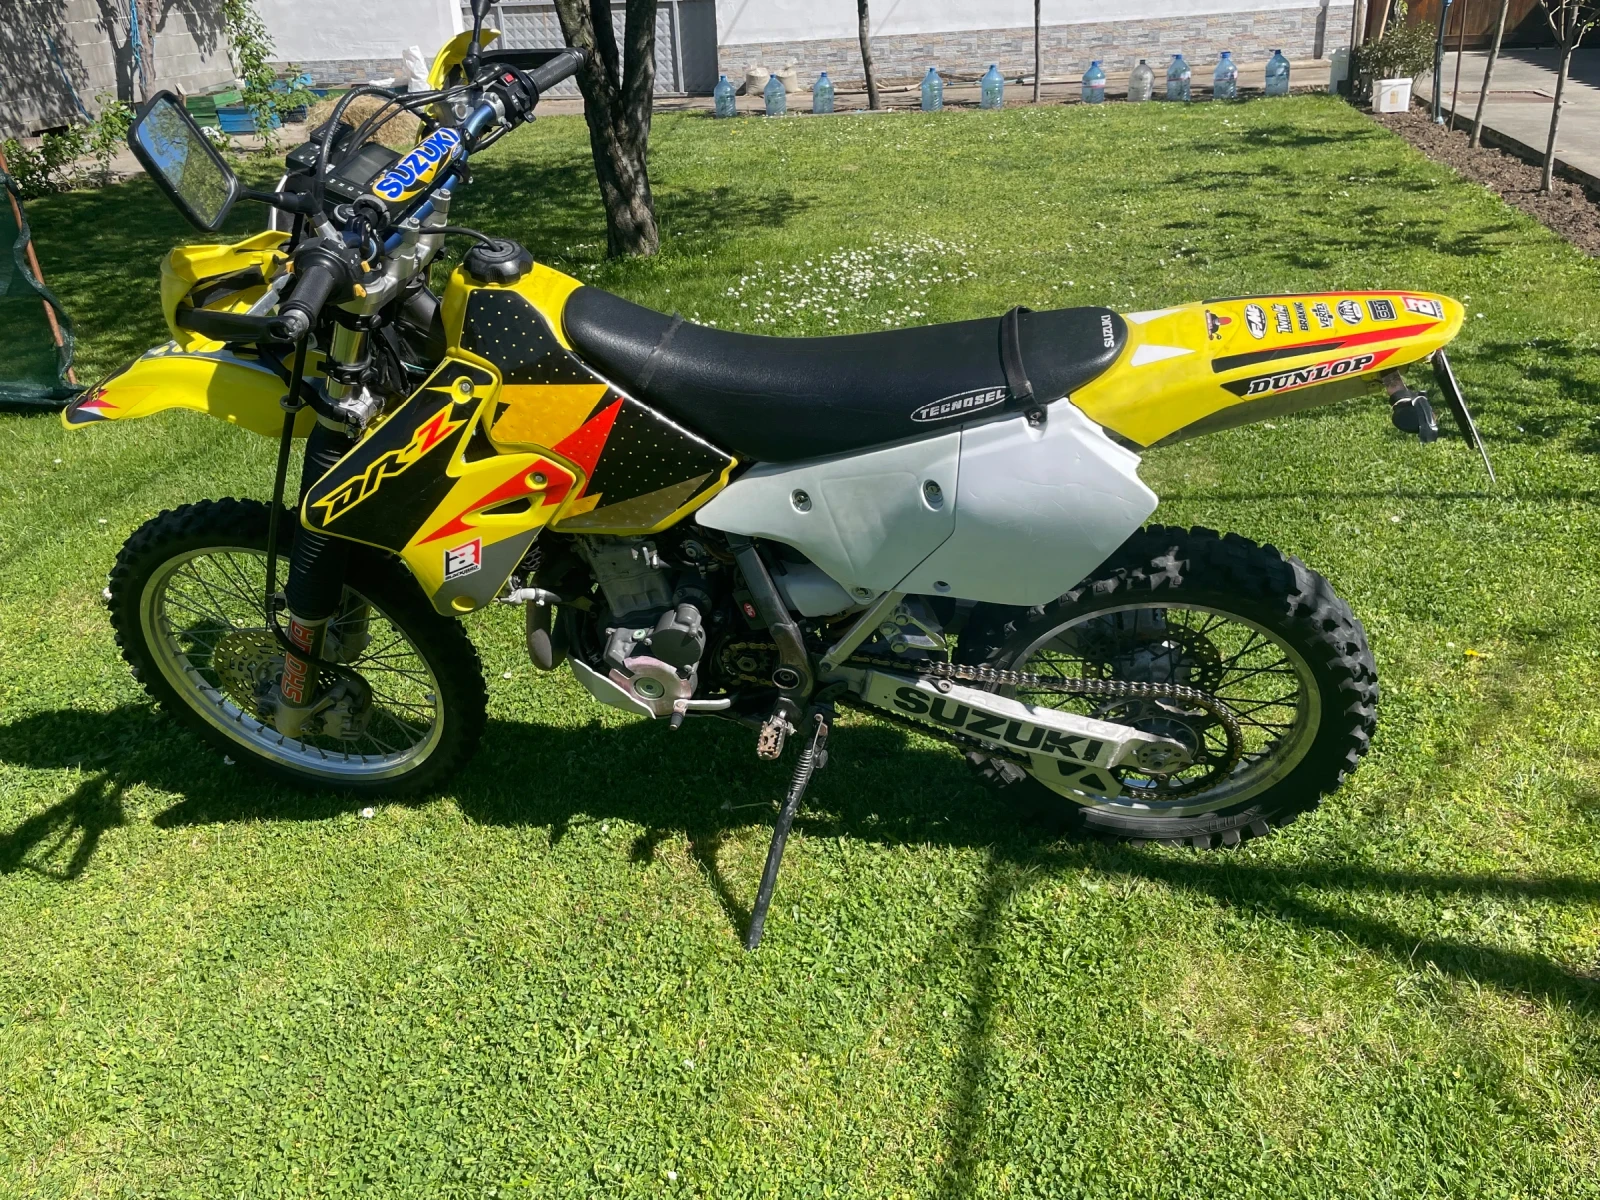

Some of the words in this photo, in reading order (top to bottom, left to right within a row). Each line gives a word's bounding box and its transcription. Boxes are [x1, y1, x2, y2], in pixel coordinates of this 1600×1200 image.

[375, 127, 461, 199] SUZUKI
[1101, 314, 1115, 348] SUZUKI
[1248, 354, 1376, 395] DUNLOP
[919, 388, 1006, 420] TECNOSEL
[893, 686, 1104, 762] SUZUKI
